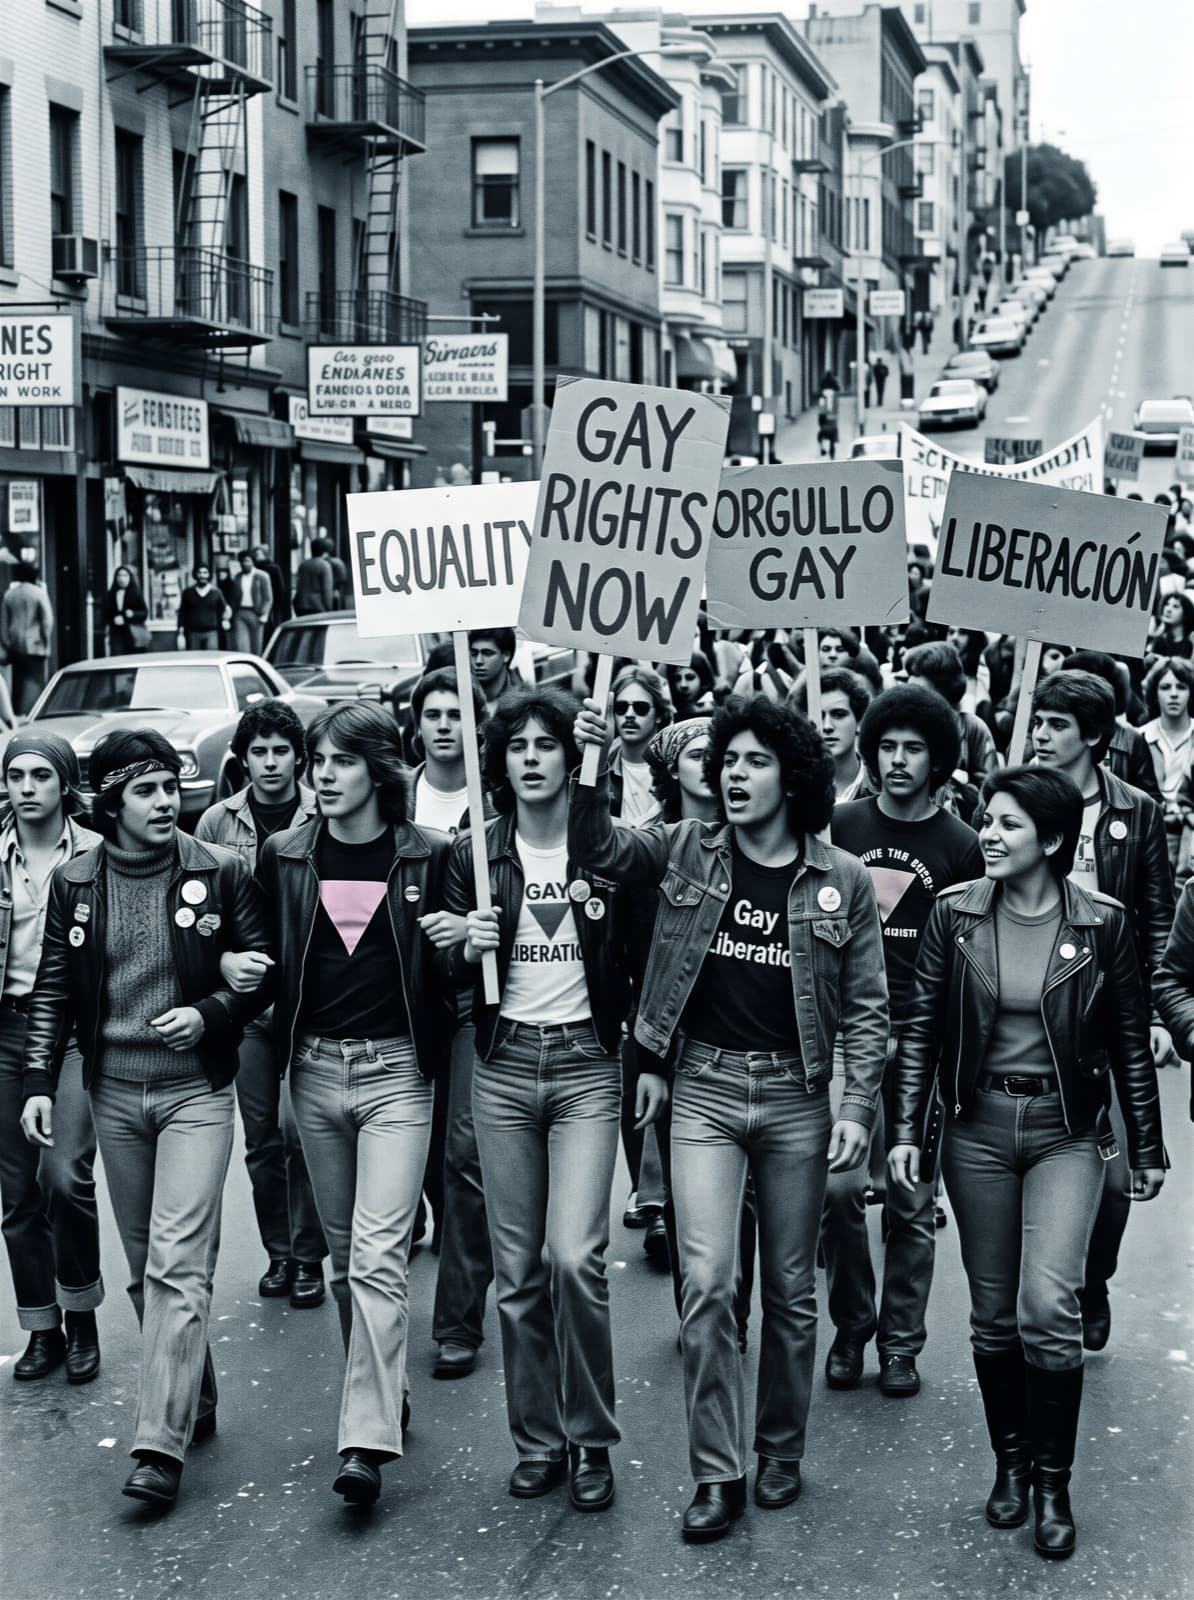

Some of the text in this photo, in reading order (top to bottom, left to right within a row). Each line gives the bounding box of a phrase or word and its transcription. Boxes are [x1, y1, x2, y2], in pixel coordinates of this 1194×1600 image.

[1, 324, 52, 355] NES
[17, 386, 62, 397] WORK
[576, 397, 696, 472] GAY
[540, 473, 708, 559] RIGHTS
[712, 485, 894, 538] ORGULLO
[749, 546, 857, 601] GAY
[941, 518, 1158, 612] LIBERACIÓN
[543, 560, 691, 645] NOW
[525, 882, 568, 900] GAY
[733, 899, 780, 936] Gay
